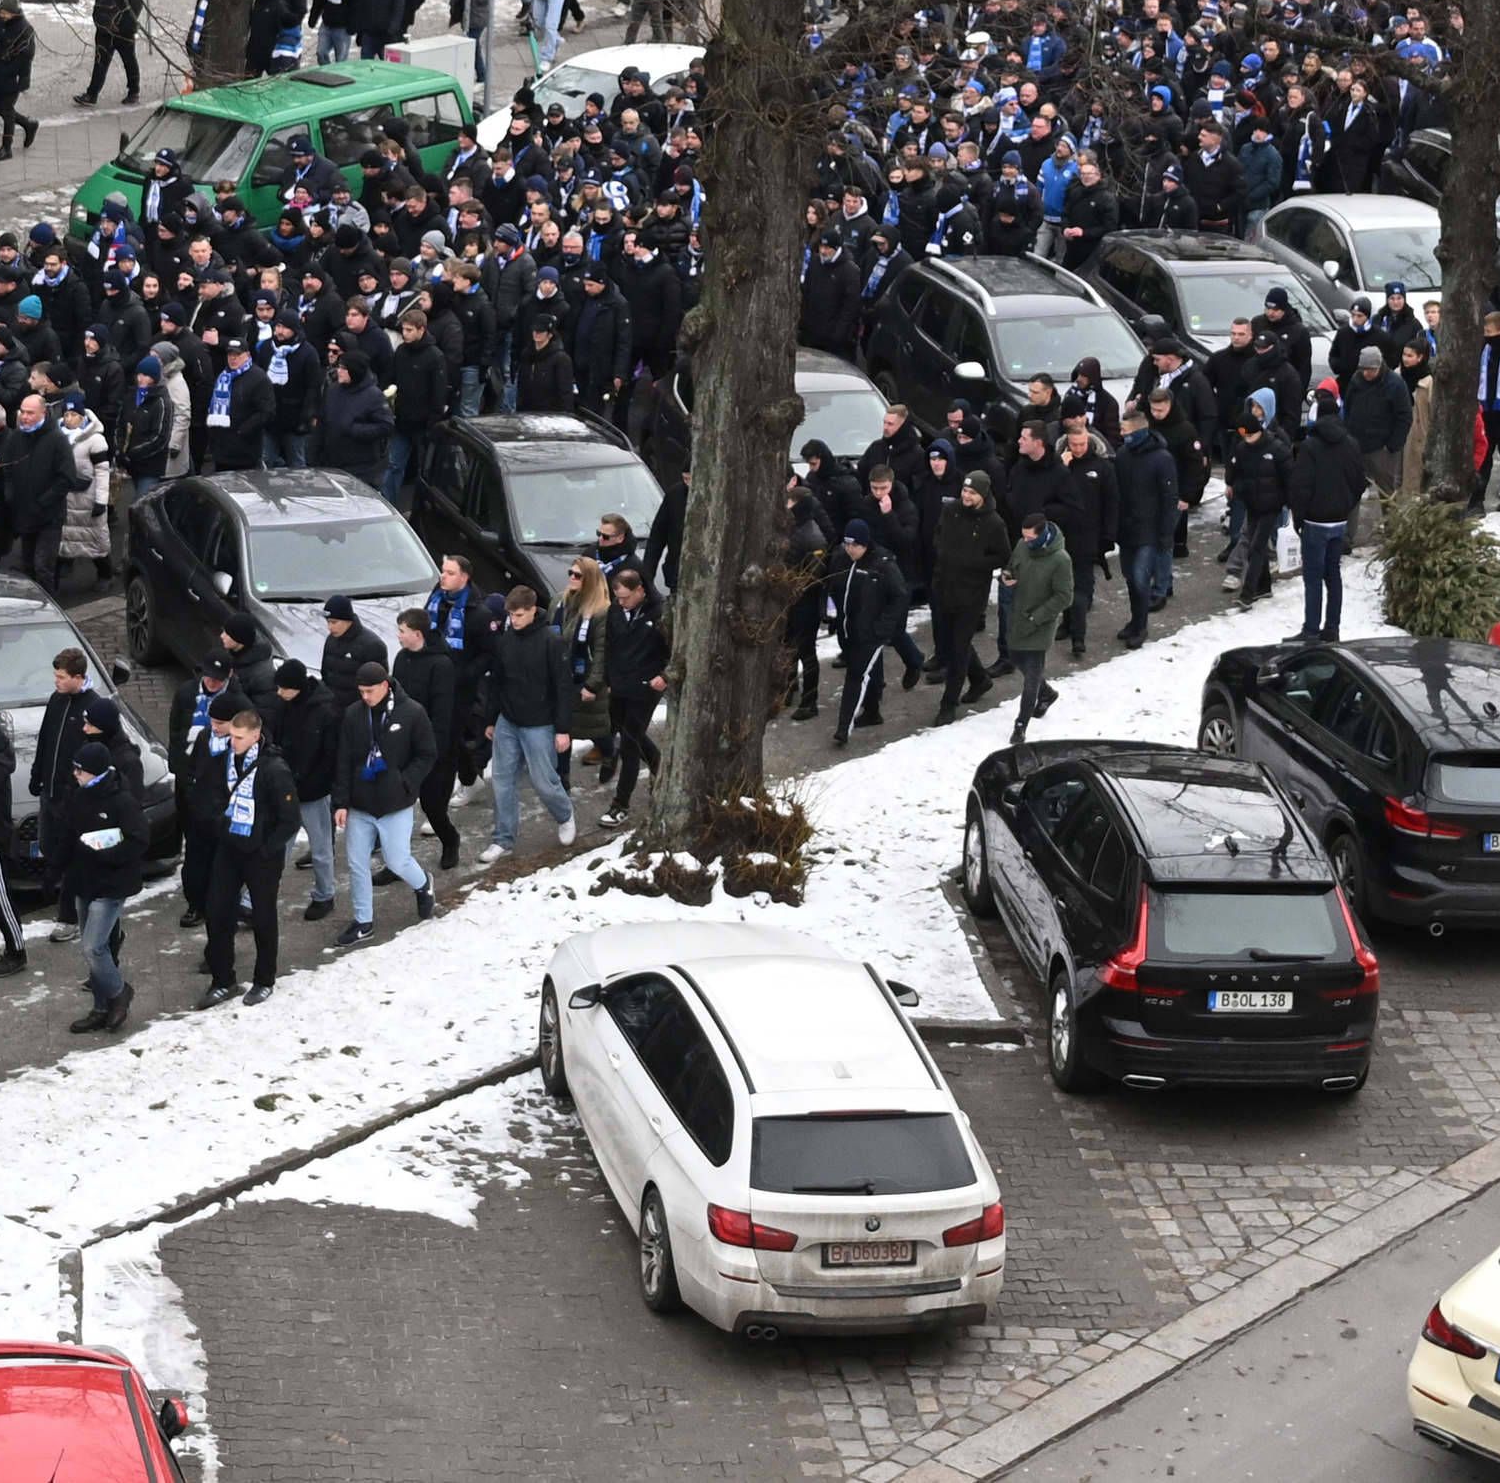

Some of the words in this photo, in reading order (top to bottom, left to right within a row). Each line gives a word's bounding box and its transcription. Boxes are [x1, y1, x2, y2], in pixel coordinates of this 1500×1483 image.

[1491, 835, 1499, 847] B
[1209, 974, 1300, 982] VOLVO
[1221, 994, 1230, 1007] B
[1239, 994, 1256, 1007] OL
[1261, 993, 1286, 1007] 138
